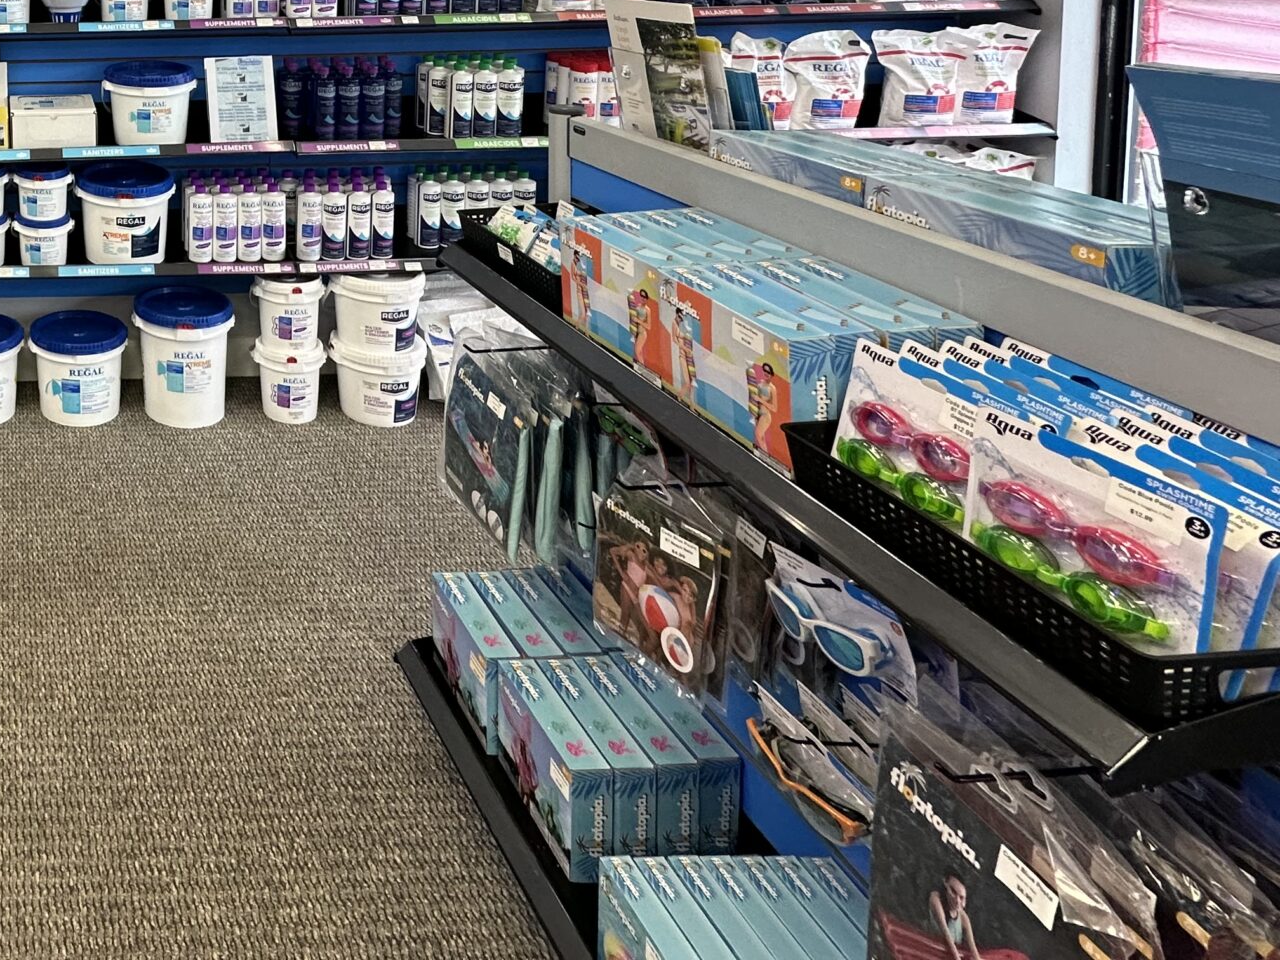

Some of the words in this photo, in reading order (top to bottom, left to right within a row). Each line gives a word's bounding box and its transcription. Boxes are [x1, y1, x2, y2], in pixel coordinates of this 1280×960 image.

[700, 8, 744, 16] BALANCERS
[806, 4, 850, 12] BALANCERS
[204, 20, 256, 28] SUPPLEMENTS
[202, 144, 253, 152] SUPPLEMENTS
[709, 145, 753, 172] floatopia.
[844, 178, 857, 188] 8+
[866, 195, 931, 230] floatopia.
[1078, 246, 1096, 260] 8+
[212, 264, 264, 272] SUPPLEMENTS
[284, 308, 309, 316] REGAL
[382, 311, 408, 320] REGAL
[659, 286, 700, 320] floatopia.
[174, 351, 206, 360] REGAL
[861, 344, 895, 368] Aqua
[907, 346, 940, 368] Aqua
[946, 346, 980, 368] Aqua
[1008, 342, 1044, 366] Aqua
[69, 367, 104, 377] REGAL
[381, 382, 408, 390] REGAL
[811, 375, 831, 422] topia.
[972, 391, 1020, 418] SPLASHTIME
[1016, 394, 1065, 420] SPLASHTIME
[1058, 394, 1109, 423] SPLASHTIME
[1090, 392, 1143, 418] SPLASHTIME
[1130, 390, 1184, 417] SPLASHTIME
[986, 412, 1034, 442] Aqua
[1084, 424, 1134, 453] Aqua
[1118, 416, 1166, 446] Aqua
[1118, 482, 1138, 496] Code
[1146, 477, 1217, 514] SPLASHTIME
[1156, 488, 1178, 504] SWIM
[1178, 498, 1215, 520] GOGGLES
[606, 498, 654, 537] floatopia.
[1192, 518, 1206, 531] 3+
[589, 794, 608, 858] floatopia.
[632, 794, 651, 857] floatopia.
[890, 766, 981, 870] floatopia.
